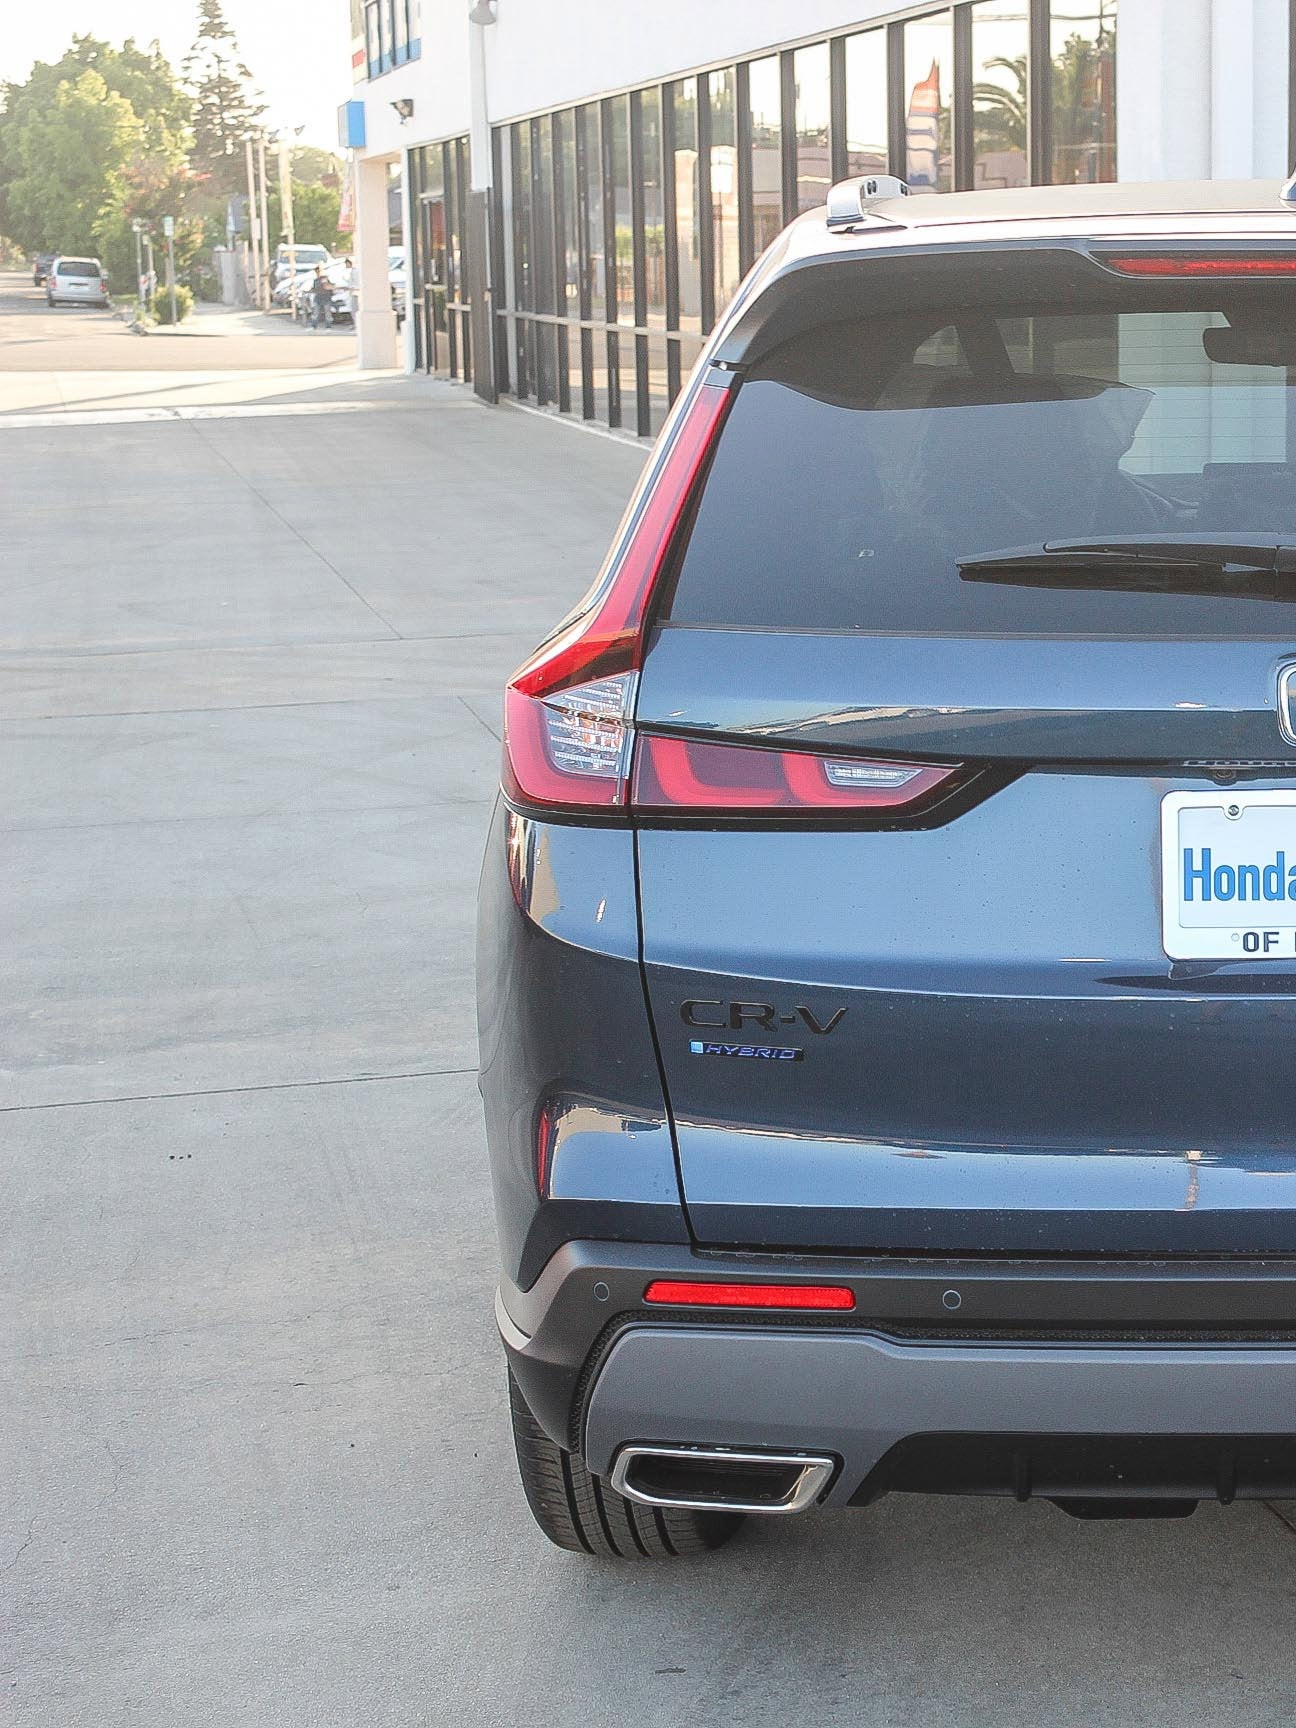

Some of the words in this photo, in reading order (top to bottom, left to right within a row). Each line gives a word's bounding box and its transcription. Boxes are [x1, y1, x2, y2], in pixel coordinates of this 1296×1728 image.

[1242, 931, 1280, 953] OF
[680, 1000, 848, 1034] CR-V
[705, 1043, 796, 1060] HYBRID
